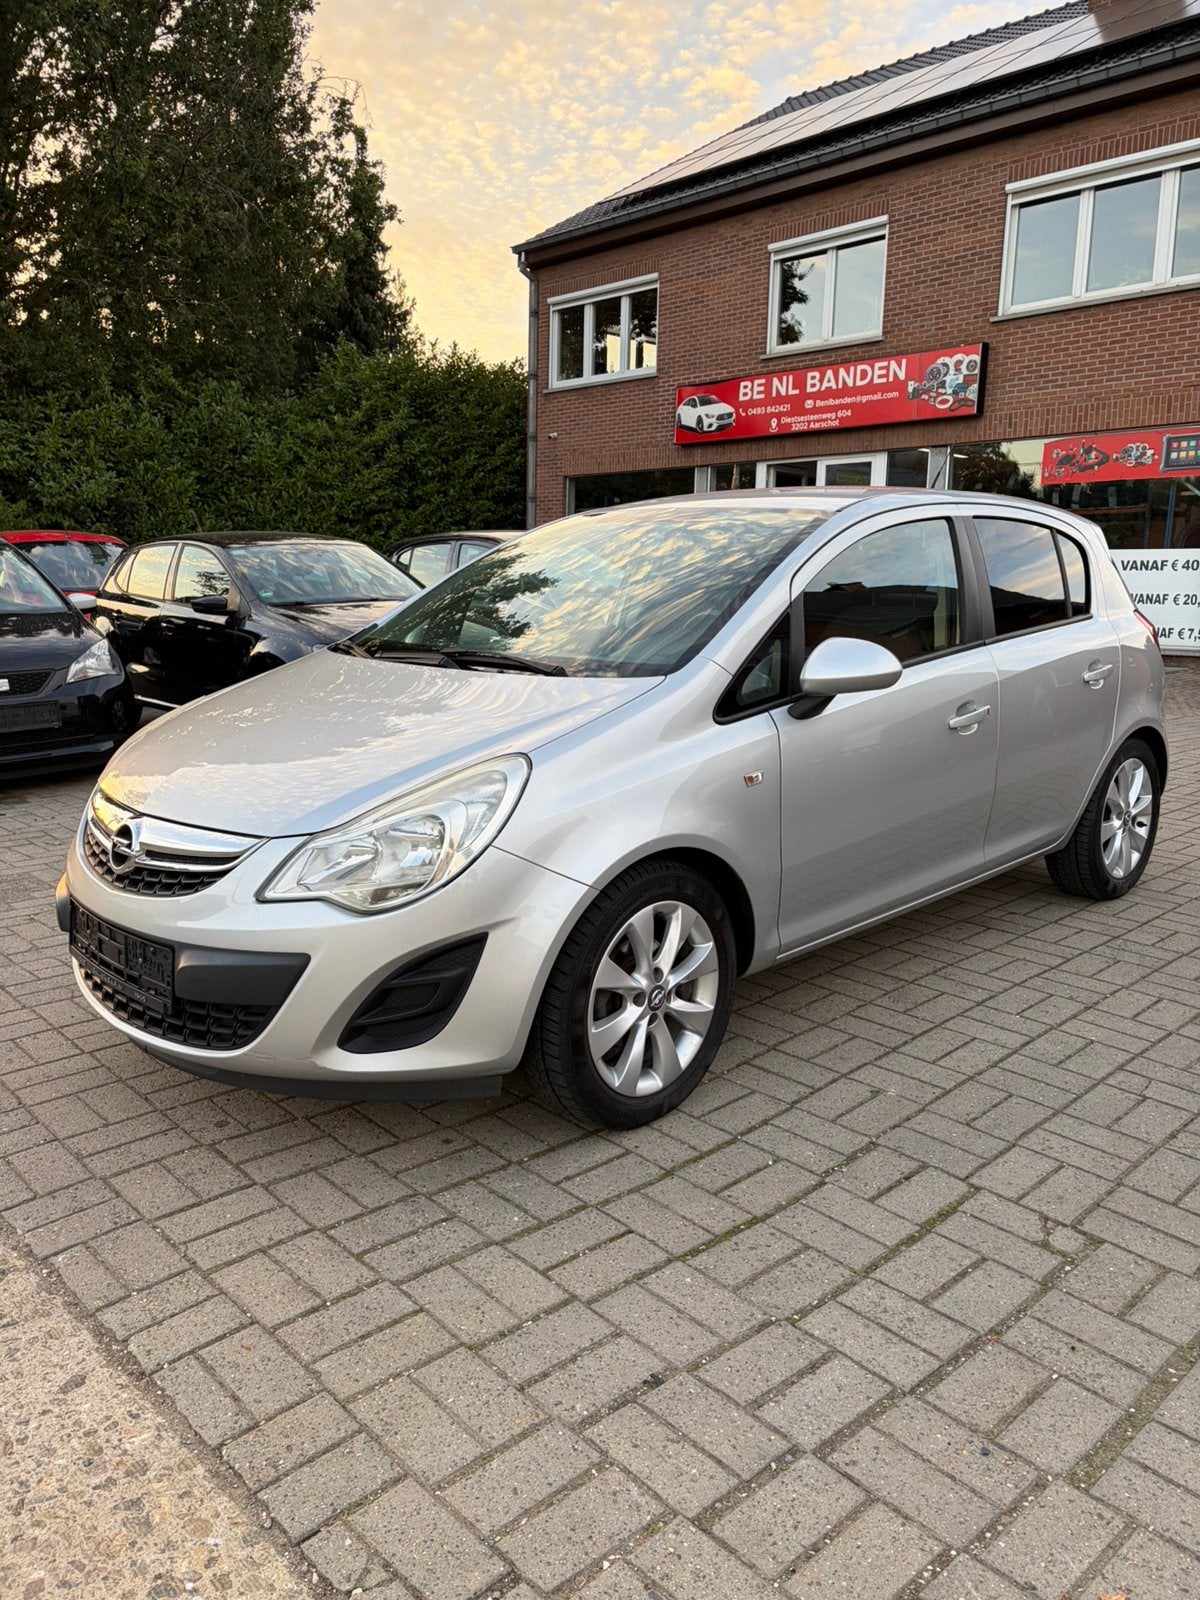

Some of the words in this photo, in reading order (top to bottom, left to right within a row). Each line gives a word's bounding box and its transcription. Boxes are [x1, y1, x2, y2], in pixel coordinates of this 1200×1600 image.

[739, 380, 765, 401] BE
[772, 375, 799, 397] NL
[806, 359, 907, 393] BANDEN
[747, 405, 766, 416] 0493
[766, 404, 791, 414] 842421
[837, 409, 852, 418] 604
[791, 422, 808, 431] 3202
[809, 419, 840, 430] Aarschot
[1120, 559, 1169, 572] VANAF
[1171, 559, 1179, 572] €
[1130, 593, 1170, 605] VANAF
[1173, 593, 1181, 606] €
[1177, 628, 1186, 640] €
